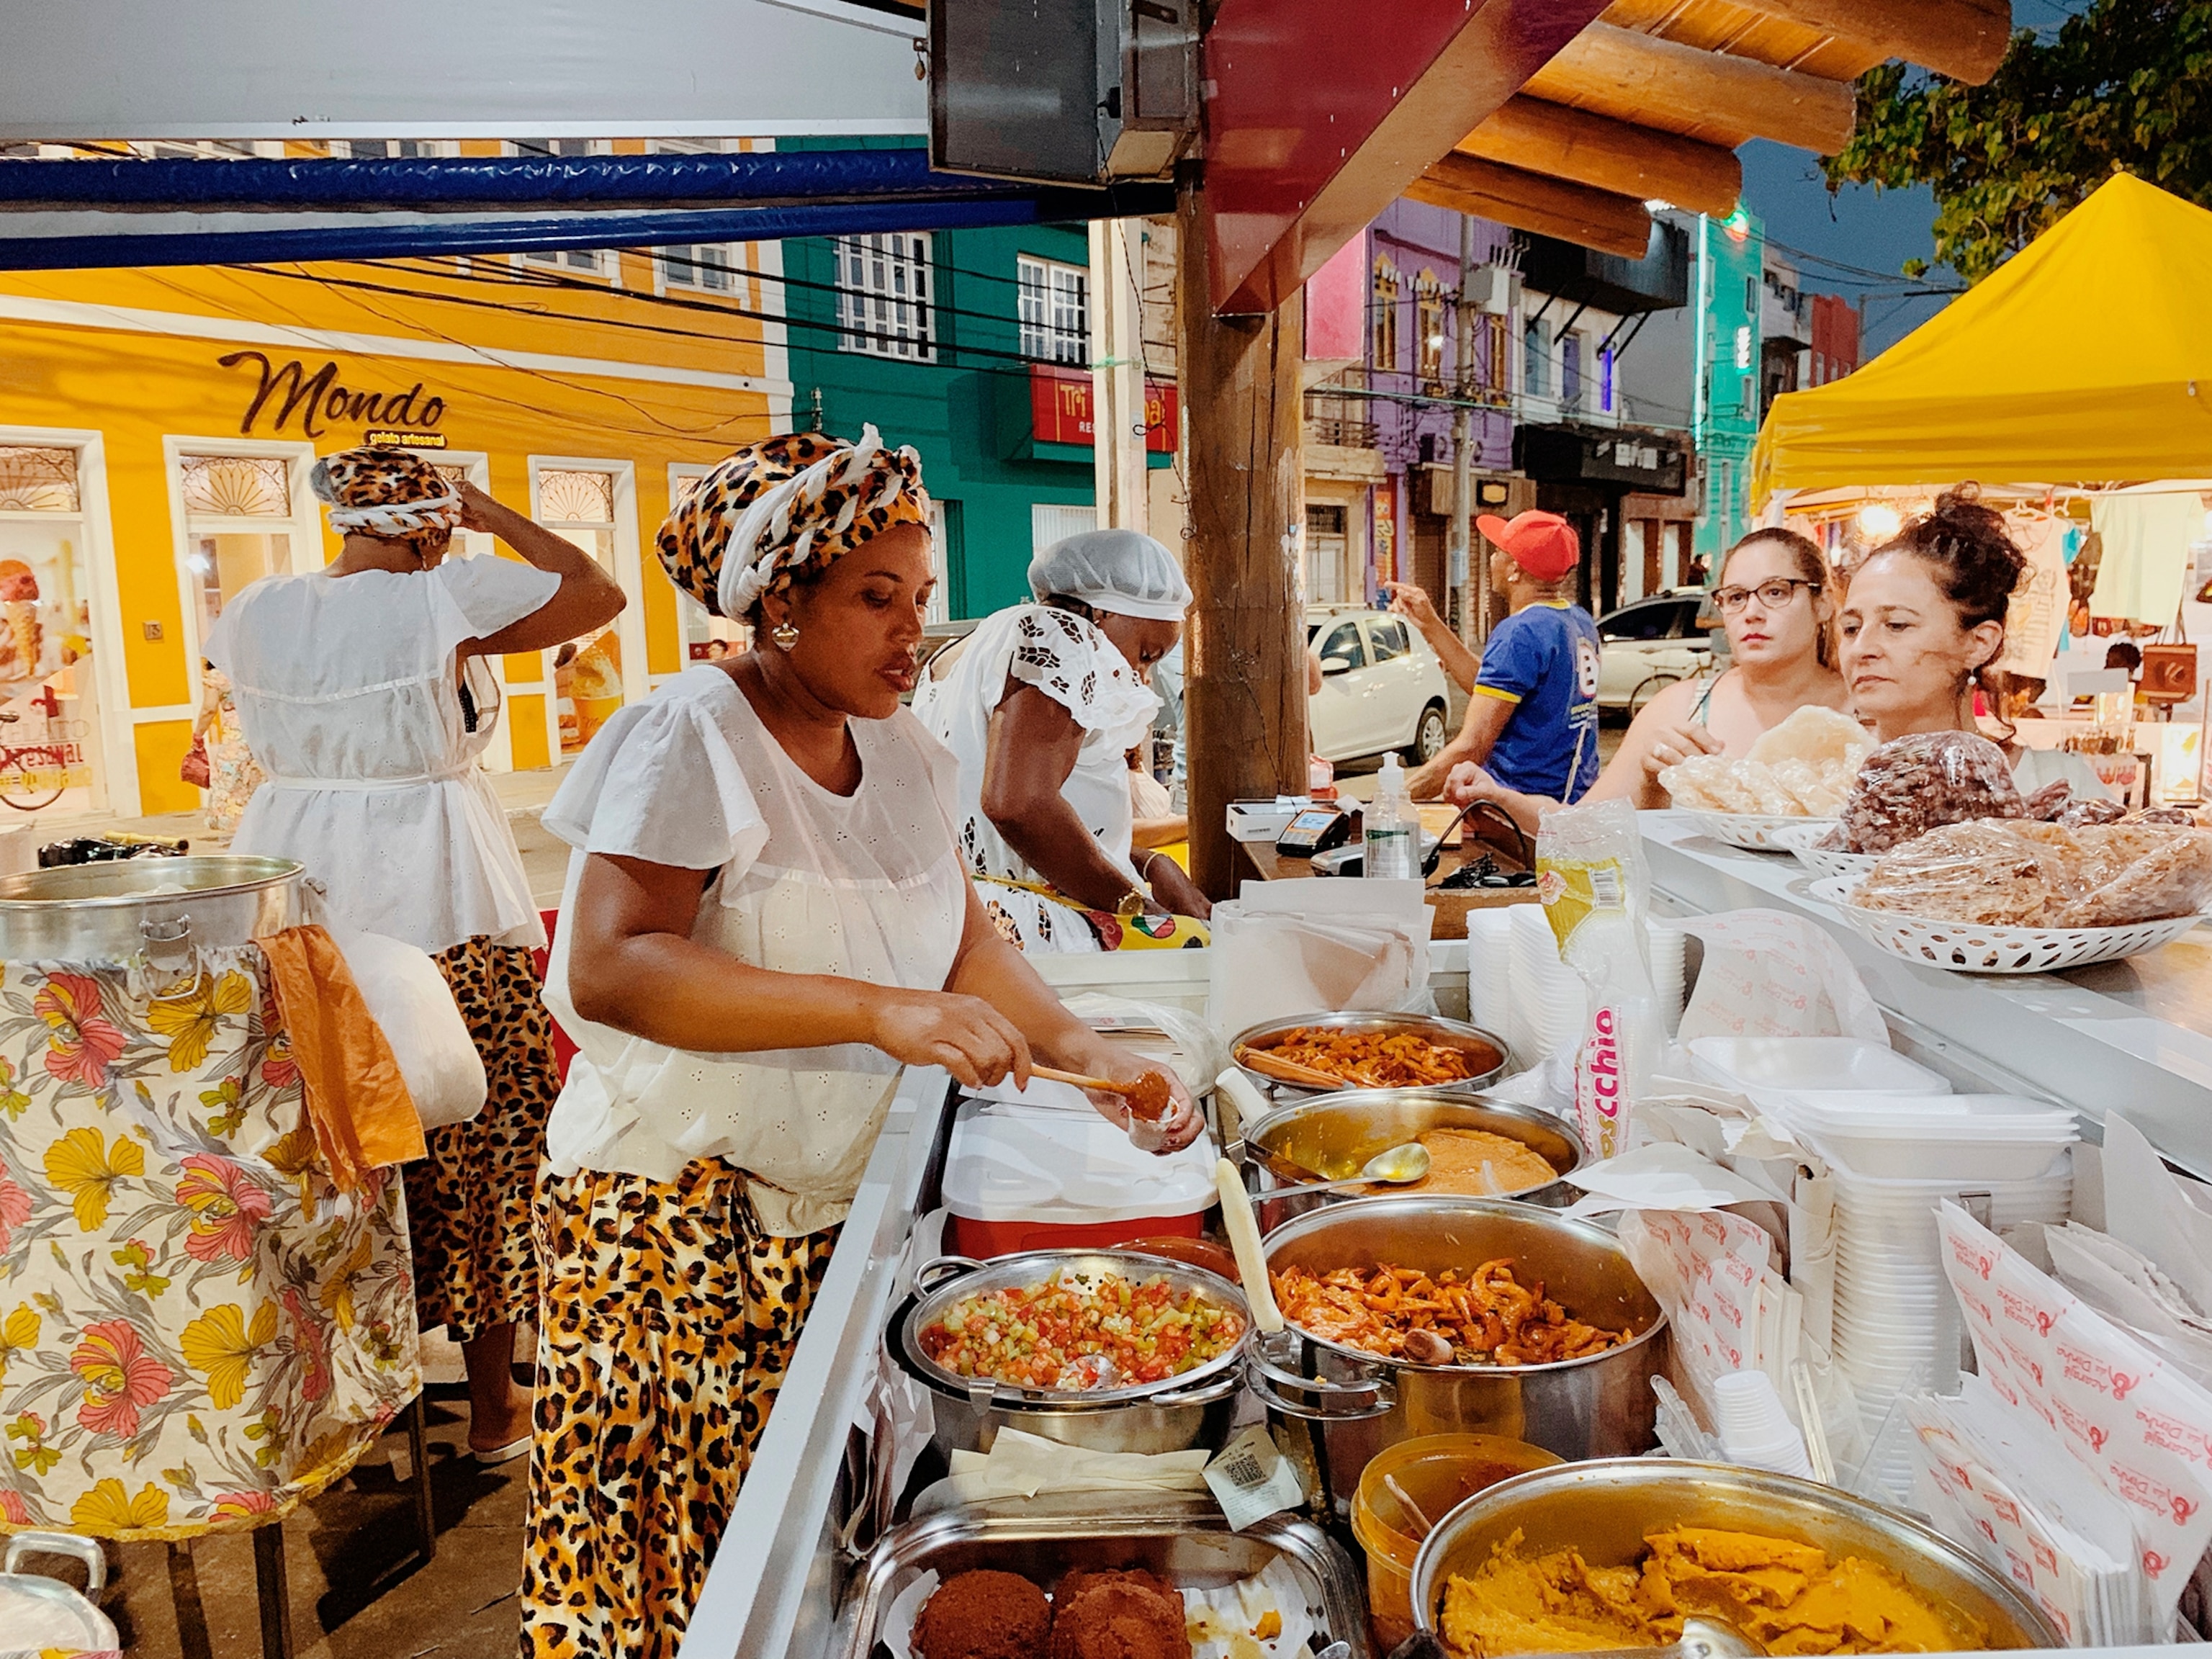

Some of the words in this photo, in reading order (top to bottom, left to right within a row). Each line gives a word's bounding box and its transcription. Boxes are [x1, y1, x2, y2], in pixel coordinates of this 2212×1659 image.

[217, 351, 446, 439] Mondo
[1060, 384, 1086, 418] Tri
[369, 431, 400, 446] gelato
[401, 433, 445, 446] artesanal
